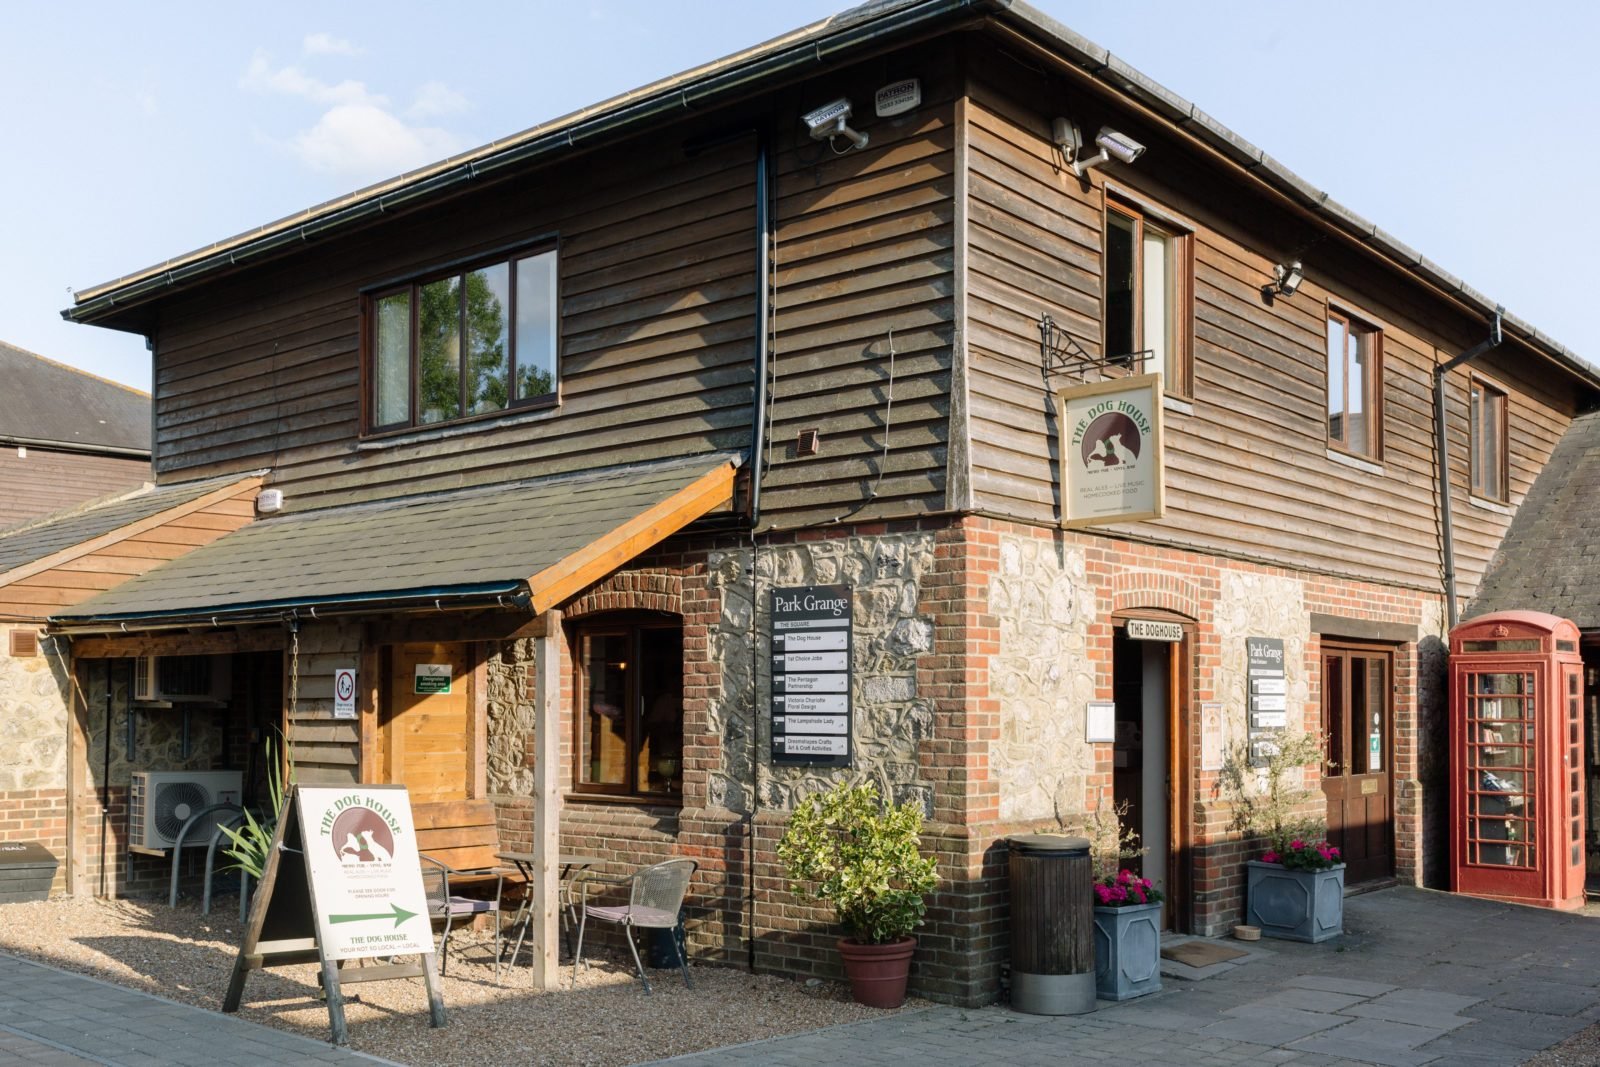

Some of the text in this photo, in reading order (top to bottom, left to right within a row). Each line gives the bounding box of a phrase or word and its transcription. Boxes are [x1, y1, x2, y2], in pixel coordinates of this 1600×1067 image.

[878, 81, 914, 102] PATRON
[815, 104, 845, 124] PATRON
[1072, 400, 1151, 446] THE DOG HOUSE
[1083, 487, 1138, 499] HOMECOOKED FOOD
[1095, 484, 1109, 492] ALES
[775, 594, 848, 616] Park Grange
[1130, 622, 1181, 639] THE DOGHOUSE
[1250, 643, 1264, 657] Park
[1263, 644, 1283, 664] Grange
[320, 794, 402, 836] THE DOG HOUSE
[350, 933, 408, 944] THE DOG HOUSE
